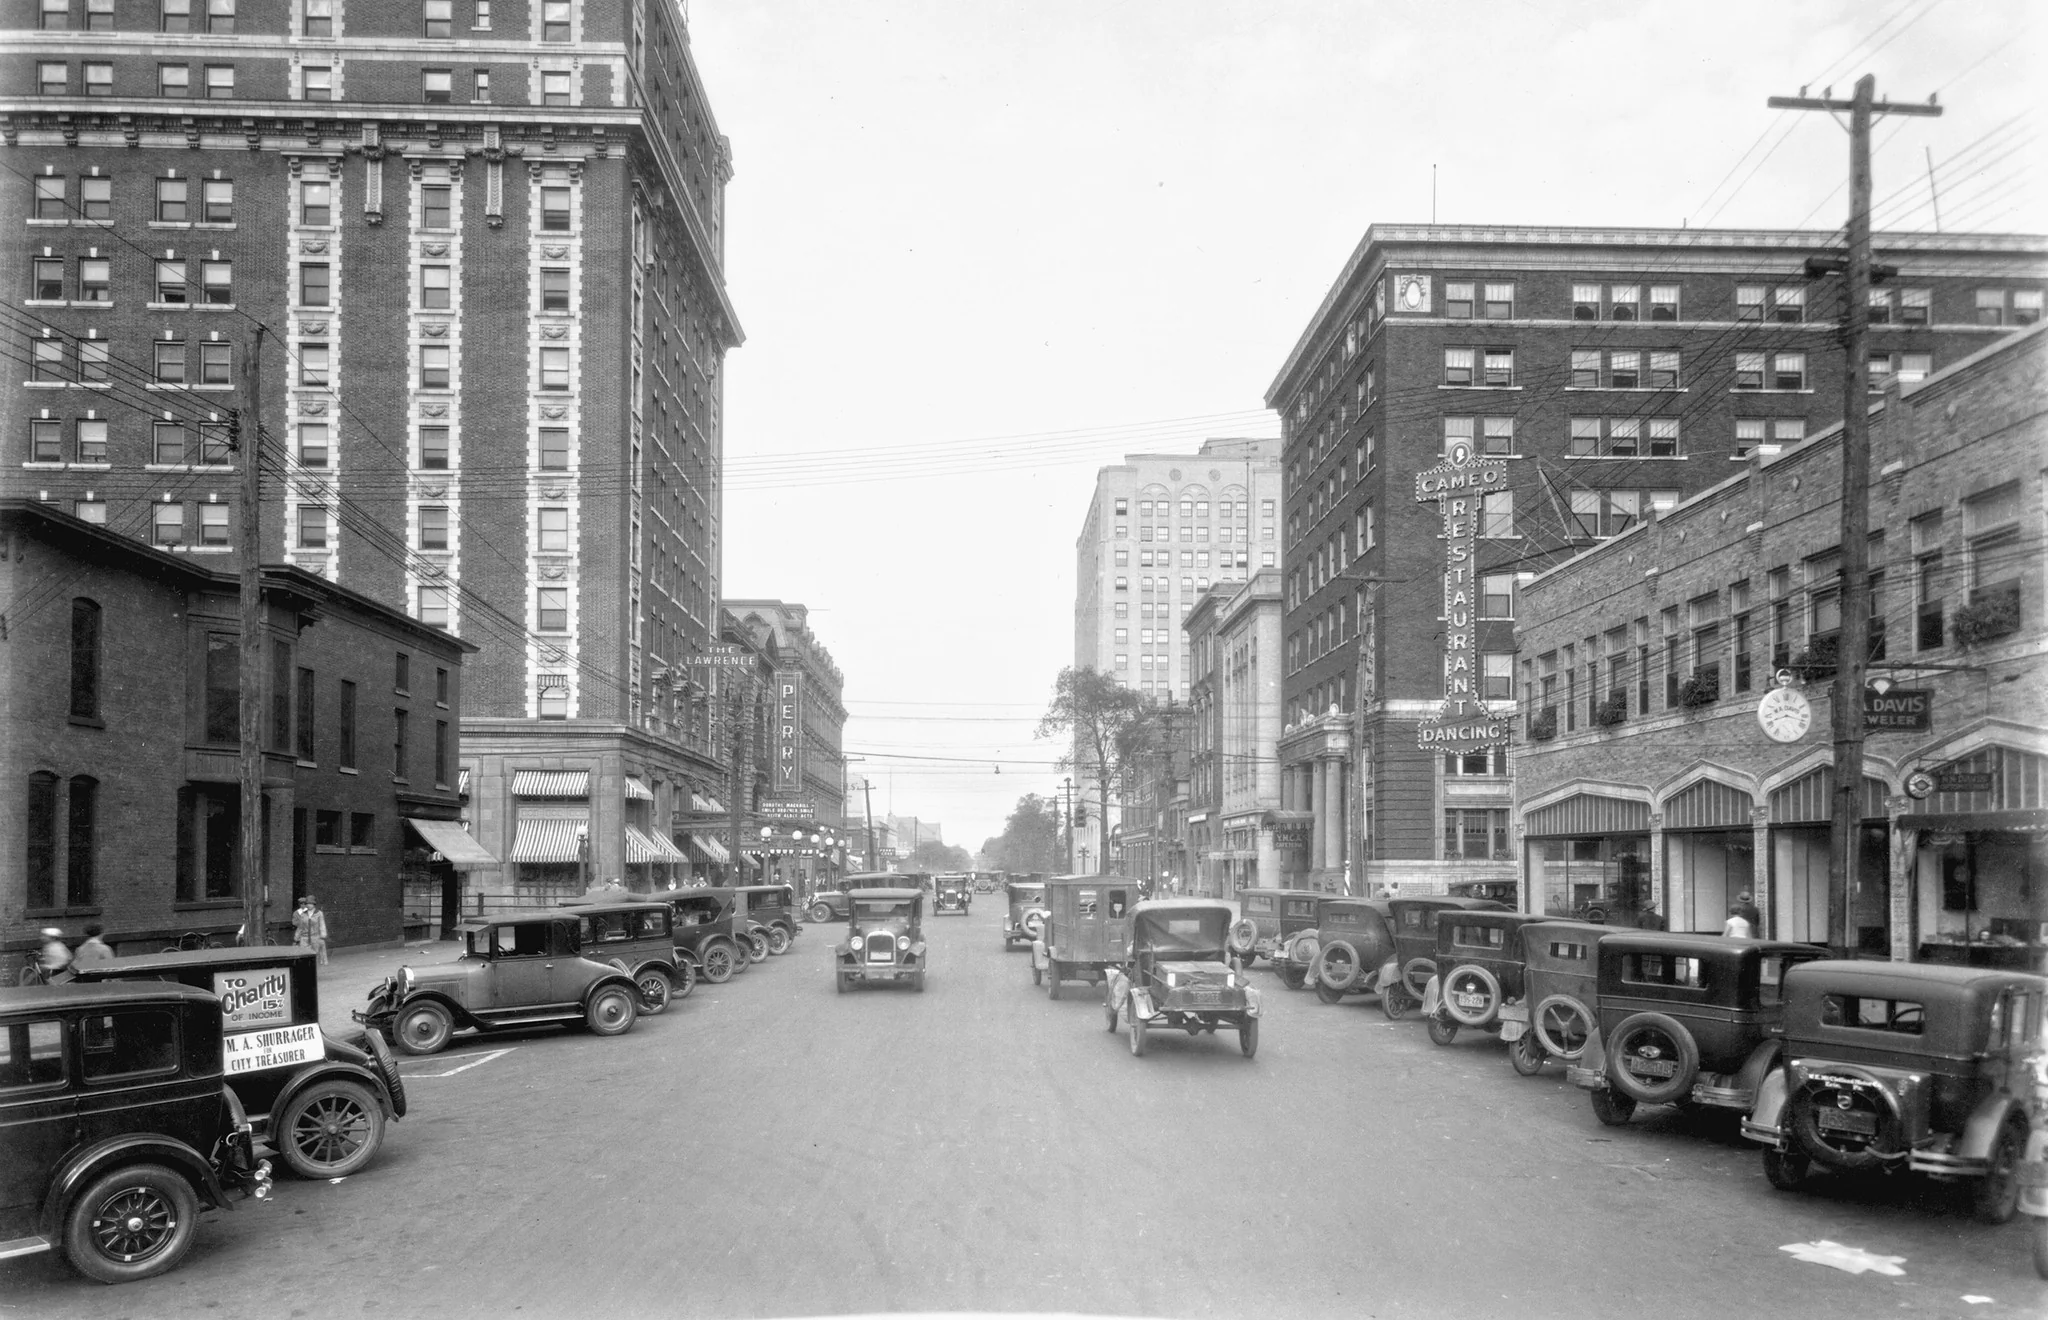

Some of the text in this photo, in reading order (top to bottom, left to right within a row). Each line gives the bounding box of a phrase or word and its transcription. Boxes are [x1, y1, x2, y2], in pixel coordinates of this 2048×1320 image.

[1421, 471, 1498, 493] CAMEO
[1452, 500, 1468, 715] RESTAURANT
[707, 646, 735, 654] THE
[686, 655, 755, 666] LAWRENCE
[1873, 696, 1925, 712] DAVIS
[1861, 715, 1917, 726] EWELER
[781, 684, 794, 779] PERRY
[1423, 724, 1500, 742] DANCING
[223, 978, 247, 988] TO
[221, 973, 287, 1015] Charity
[248, 1010, 284, 1021] INCOME
[226, 1026, 315, 1053] M. A. SHURRAGER
[231, 1049, 305, 1071] CITY TREASURER
